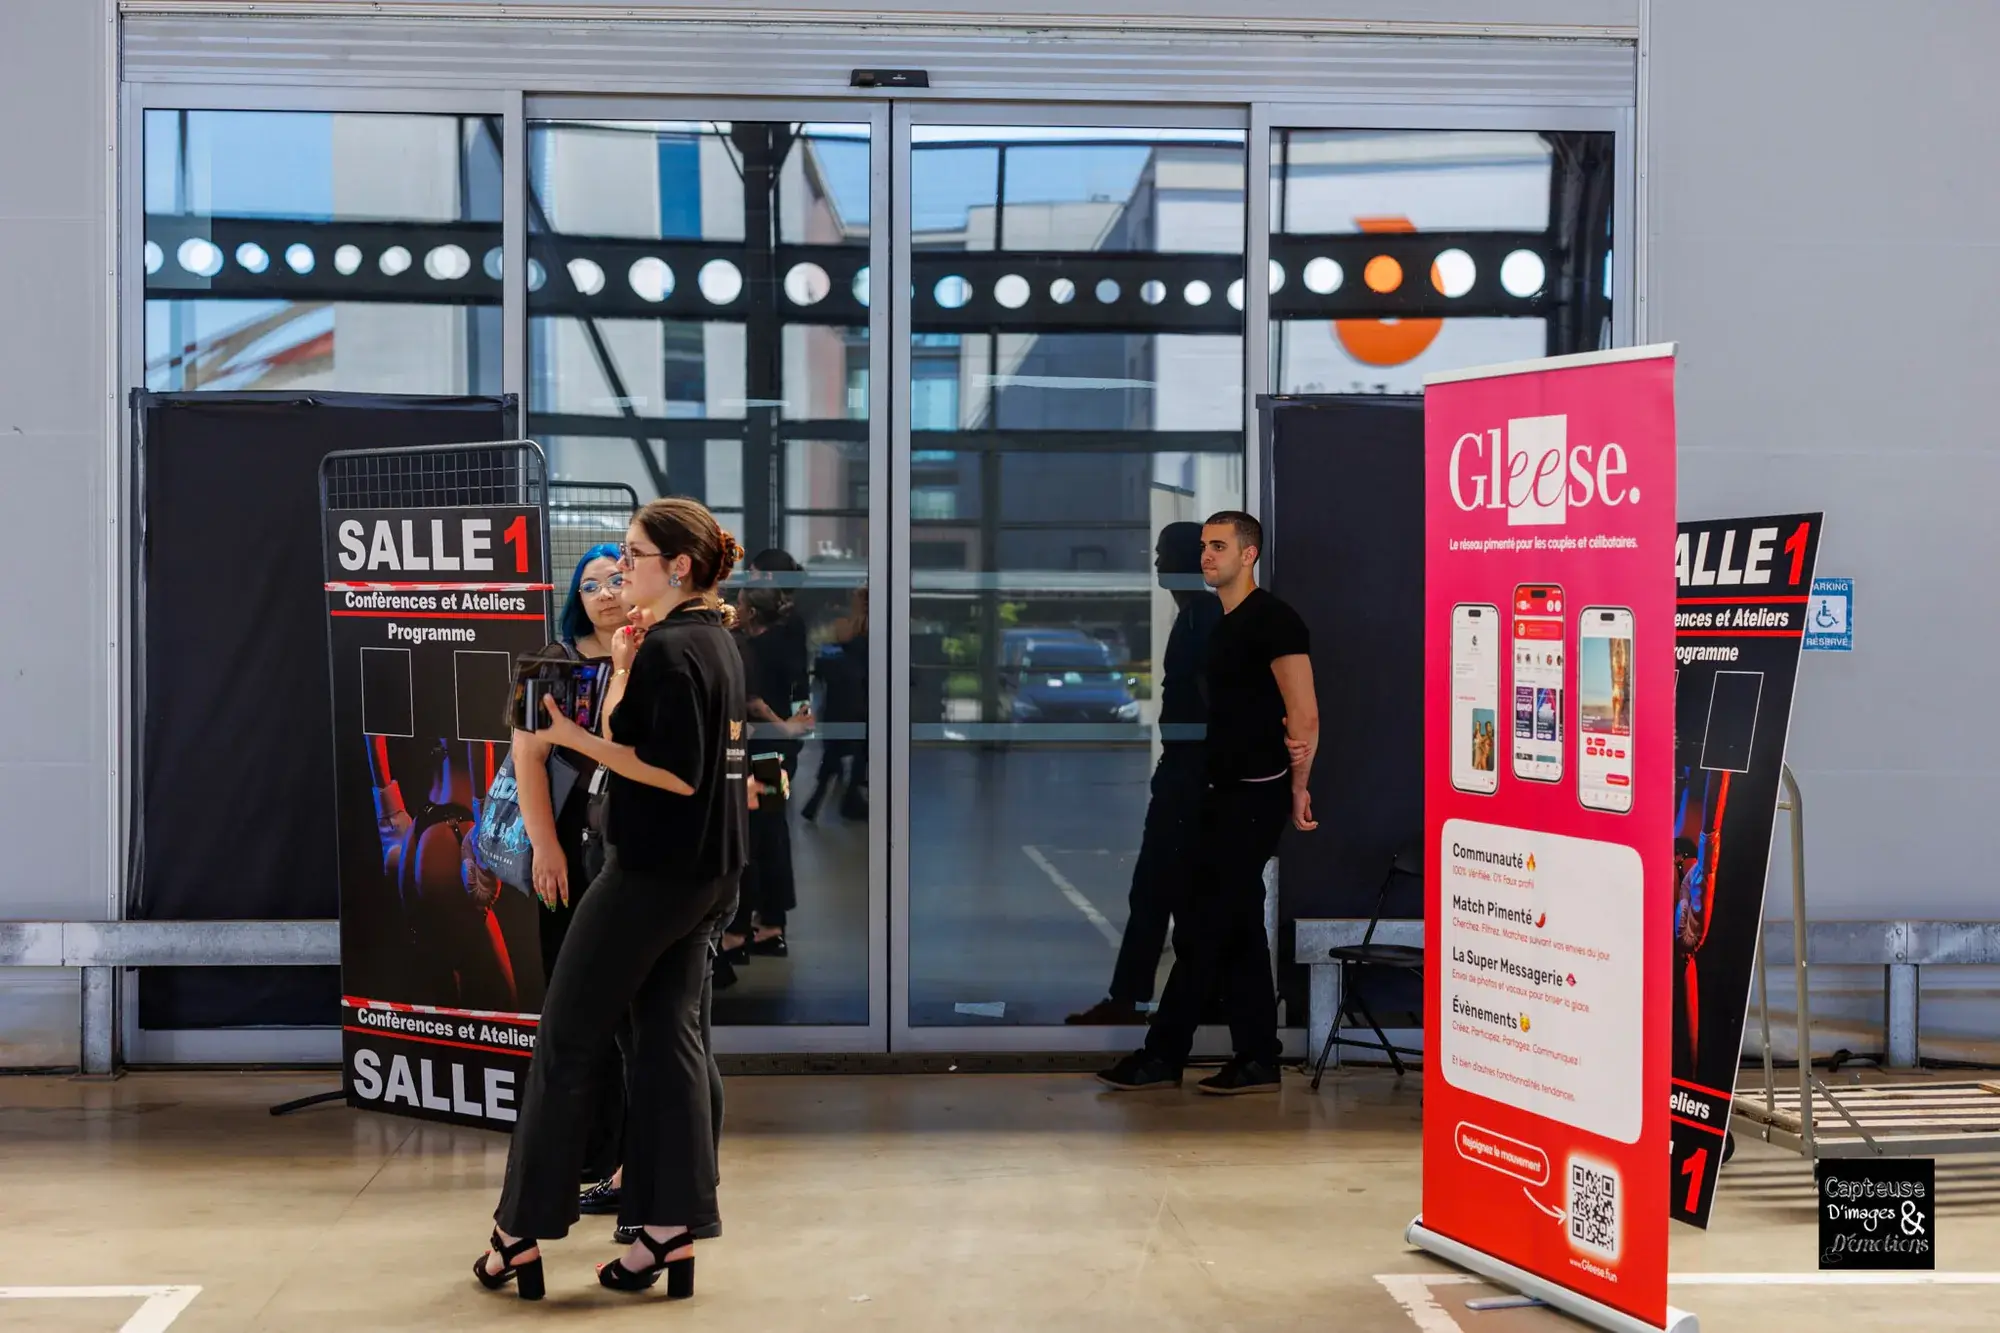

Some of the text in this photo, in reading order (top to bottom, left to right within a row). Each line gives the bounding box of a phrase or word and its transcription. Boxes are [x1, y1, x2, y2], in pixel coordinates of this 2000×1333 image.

[1449, 428, 1641, 511] Gleese.
[338, 515, 529, 573] SALLE 1
[1450, 538, 1459, 550] Le
[1460, 537, 1483, 550] réseau
[1484, 537, 1515, 552] pimenté
[1516, 538, 1533, 552] pour
[1534, 536, 1546, 549] les
[1548, 536, 1576, 552] couples
[1577, 536, 1587, 548] et
[1674, 521, 1811, 586] ALLE 1
[441, 593, 457, 610] et
[462, 592, 526, 611] Ateliers
[1813, 582, 1849, 591] ARKING
[1715, 608, 1731, 627] et
[1732, 607, 1790, 627] Ateliers
[388, 622, 476, 644] Programme
[1453, 842, 1524, 869] Communauté
[1453, 894, 1533, 925] Match Pimenté
[1453, 946, 1563, 986] La Super Messagerie
[1453, 994, 1518, 1029] Évènements
[458, 1025, 475, 1040] et
[479, 1024, 537, 1048] Atelier
[353, 1048, 518, 1122] SALLE
[1669, 1091, 1711, 1120] eliers
[1680, 1147, 1708, 1215] 1
